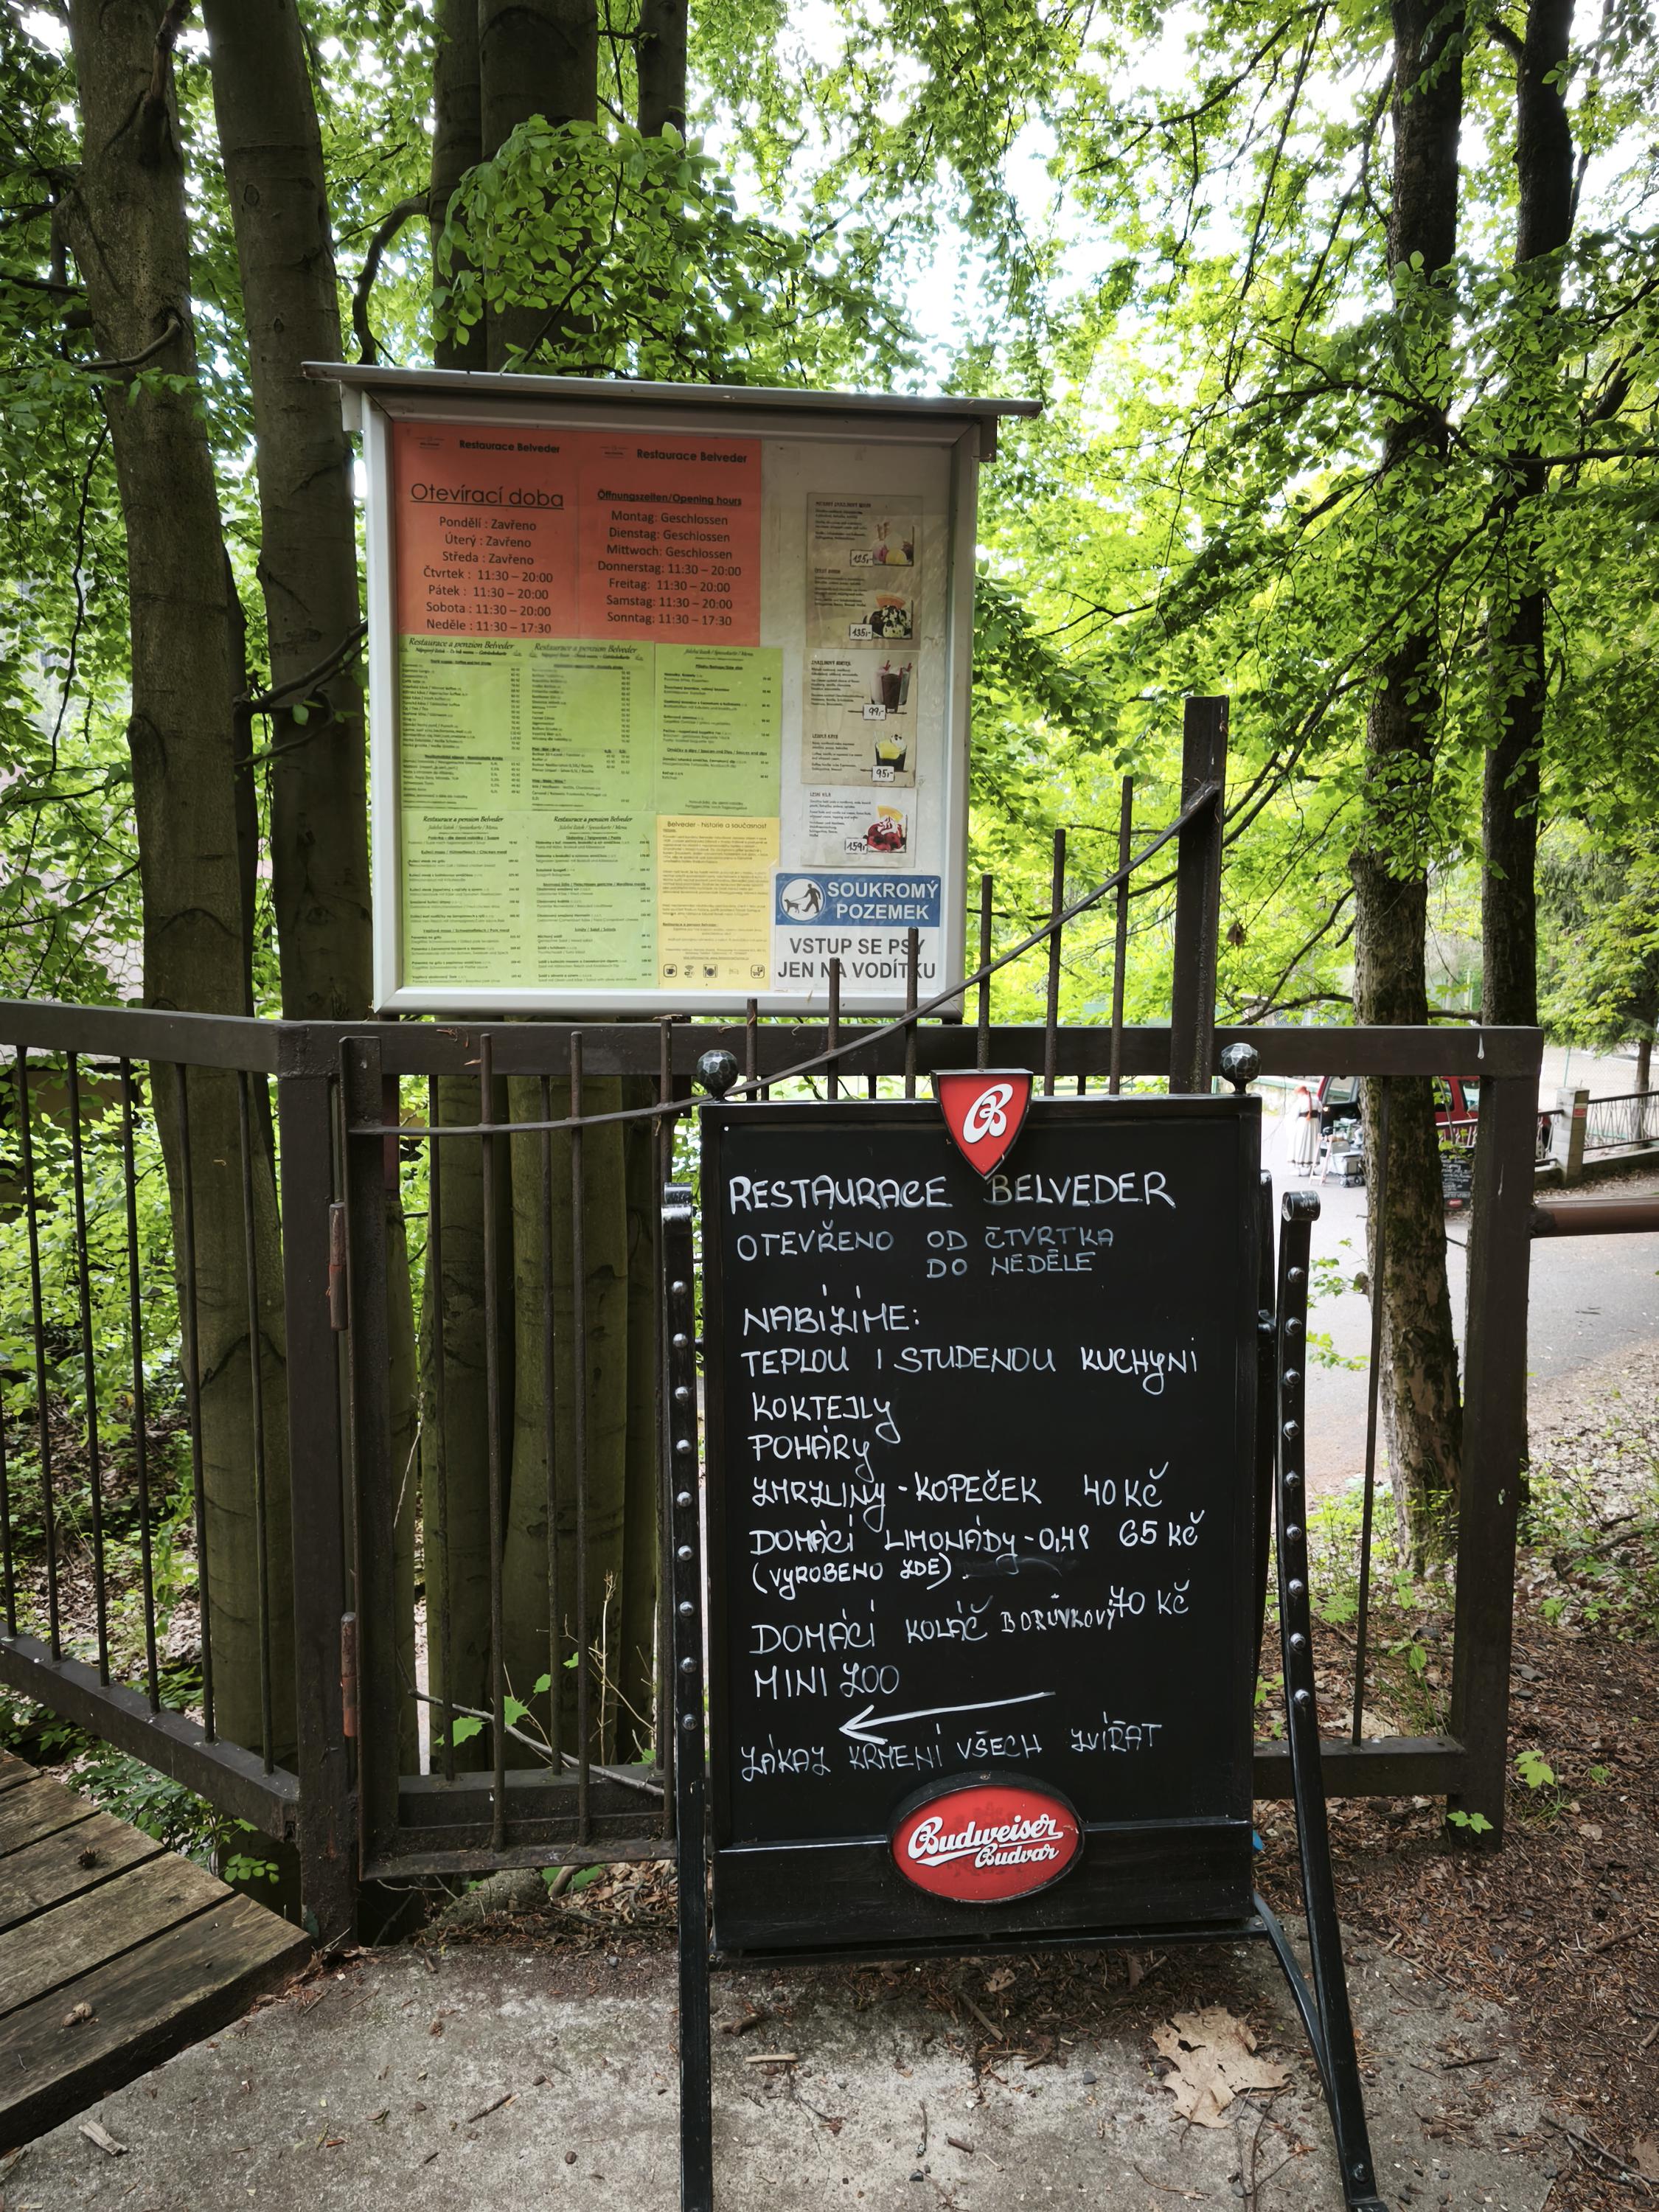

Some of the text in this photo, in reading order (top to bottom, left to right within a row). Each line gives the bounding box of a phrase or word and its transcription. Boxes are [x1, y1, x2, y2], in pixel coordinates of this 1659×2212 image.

[459, 440, 560, 453] Restaurace Belveder
[637, 449, 747, 463] Restaurace Belveder
[411, 484, 564, 507] Otevírací doba
[717, 496, 742, 505] hours
[439, 517, 481, 528] Pondělí
[491, 519, 536, 531] Zavřeno
[611, 510, 728, 525] Montag: Geschlossen
[445, 532, 476, 547] Úterý
[486, 536, 532, 548] Zavřeno
[609, 527, 730, 542] Dienstag: Geschlossen
[442, 552, 479, 562] Středa
[489, 554, 534, 565] Zavřeno
[607, 545, 732, 559] Mittwoch: Geschlossen
[423, 566, 465, 579] Čtvrtek
[478, 570, 509, 580] 11:30
[522, 572, 553, 582] 20:00
[598, 561, 664, 575] Donnerstag:
[668, 563, 698, 574] 11:30
[712, 566, 741, 576] 20:00
[428, 584, 460, 596] Pátek
[473, 587, 504, 598] 11:30
[518, 589, 549, 599] 20:00
[609, 578, 650, 591] Freitag:
[657, 580, 687, 591] 11:30
[700, 582, 730, 592] 20:00
[426, 602, 465, 613] Sobota
[476, 605, 507, 615] 11:30
[520, 606, 551, 616] 20:00
[607, 595, 655, 608] Samstag:
[659, 597, 689, 608] 11:30
[703, 599, 732, 609] 20:00
[427, 619, 466, 630] Neděle
[476, 621, 507, 631] 11:30
[521, 623, 551, 633] 17:30
[608, 612, 655, 625] Sonntag:
[659, 614, 689, 625] 11:30
[703, 616, 731, 626] 17:30
[409, 638, 447, 647] Restaurace
[454, 641, 483, 650] penzion
[484, 641, 515, 650] Belveder
[731, 821, 767, 830] současnost
[827, 880, 939, 898] SOUKROMÝ
[837, 904, 929, 919] POZEMEK
[790, 938, 852, 954] VSTUP
[858, 939, 881, 955] SE
[778, 961, 813, 978] JEN
[729, 1171, 1177, 1214] RESTAURACE BELVEDER
[737, 1220, 1114, 1262] OTEVŘENO OD ČTVRTKA
[928, 1249, 1095, 1279] DO NEDĚLE
[741, 1346, 850, 1377] TEPLOU
[893, 1346, 1057, 1373] STUDENOU
[752, 1391, 900, 1444] KOKTEJLY
[748, 1425, 874, 1483] POHÁRY
[752, 1478, 886, 1531] ZMRZLINY
[914, 1469, 1042, 1504] KOPEČEK
[1083, 1475, 1116, 1507] 40
[749, 1514, 855, 1556] DOMÁCÍ
[884, 1514, 1019, 1574] LIMONÁDY
[1119, 1520, 1159, 1548] 65
[900, 1551, 953, 1590] ZDE)
[749, 1599, 876, 1654] DOMÁCÍ
[905, 1594, 993, 1643] KOLÁČ
[754, 1662, 900, 1700] MINI ZOO
[741, 1711, 1163, 1781] ZÁKAZ KRMENÍ VŠECH ZVÍŘAT
[908, 1814, 1063, 1860] Budweiser
[975, 1843, 1060, 1868] Budvar
